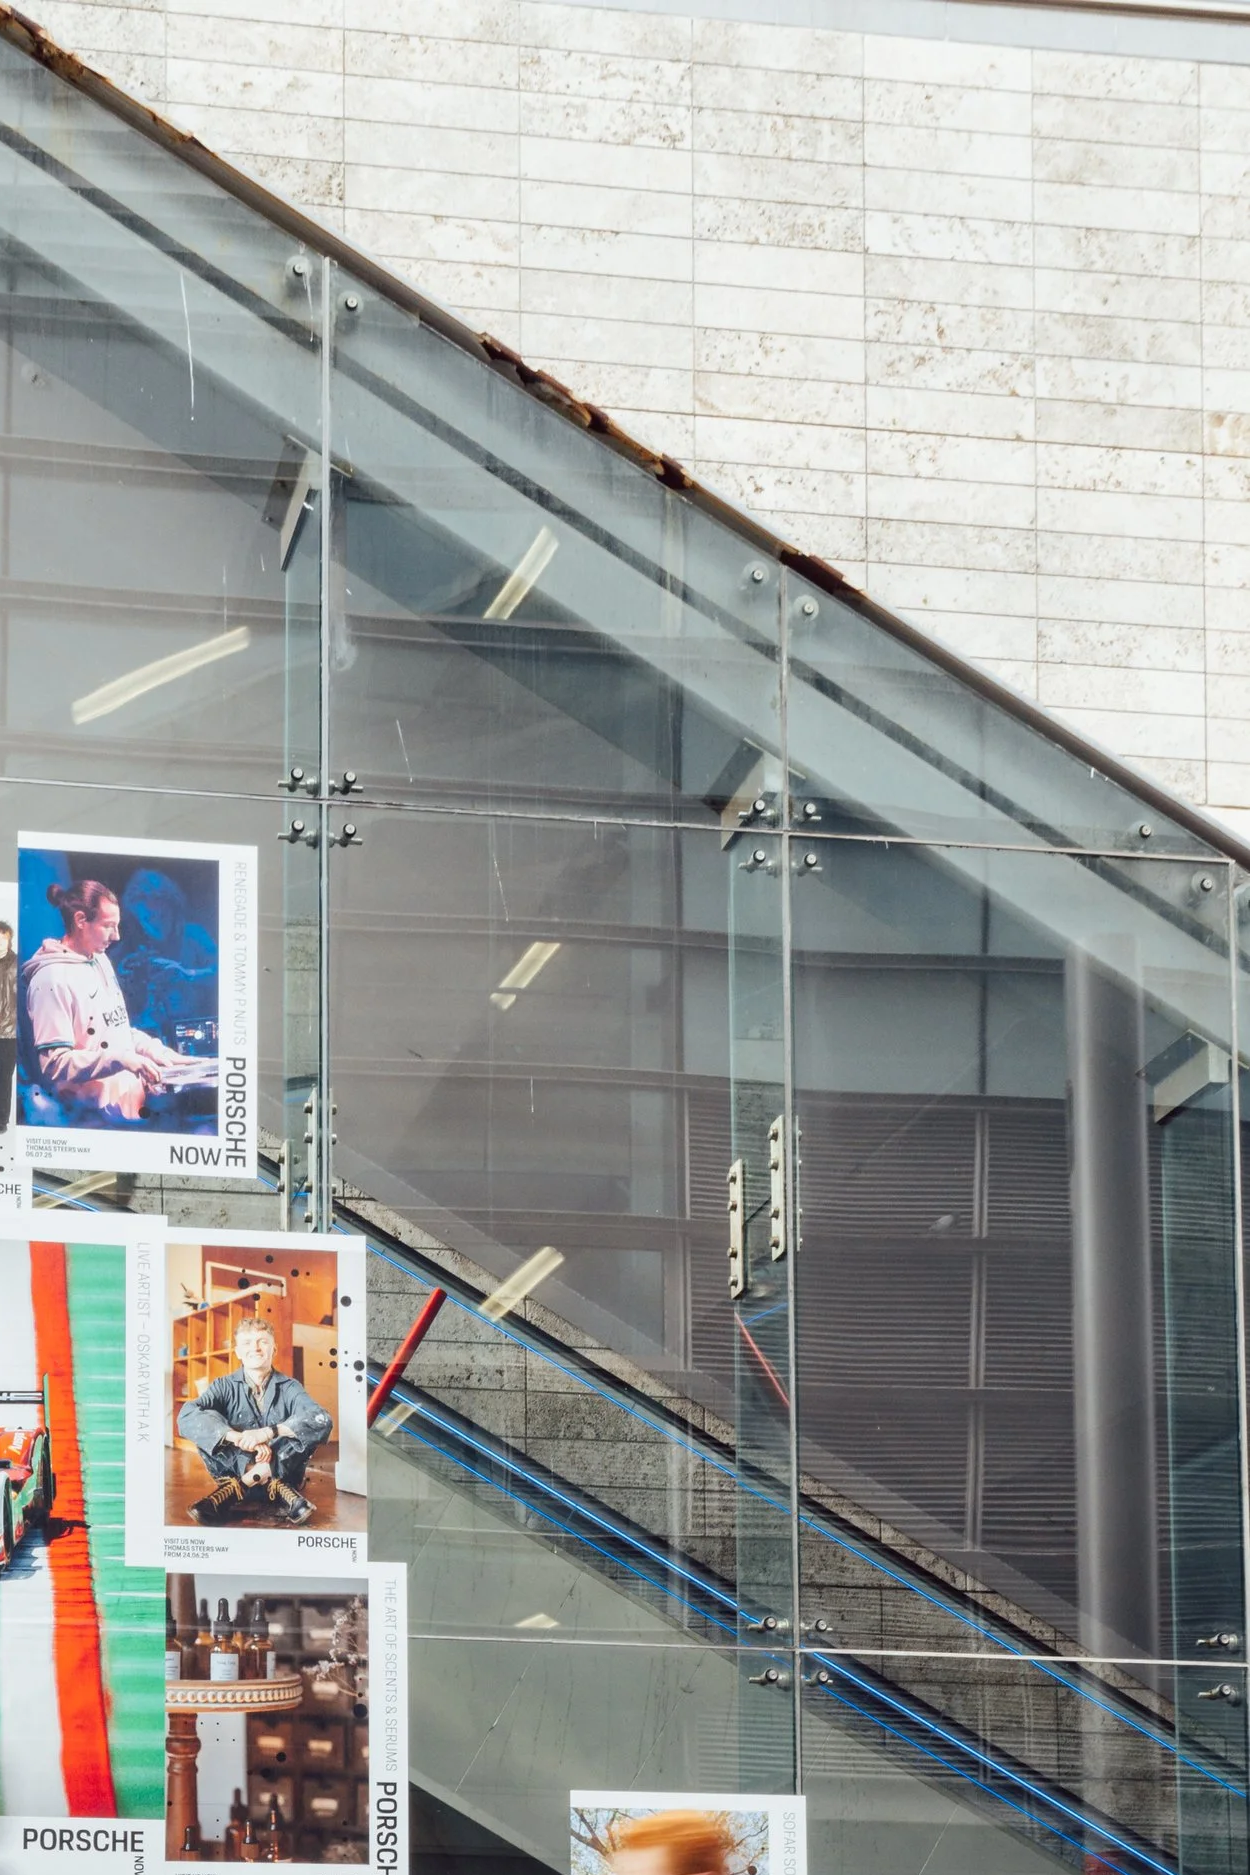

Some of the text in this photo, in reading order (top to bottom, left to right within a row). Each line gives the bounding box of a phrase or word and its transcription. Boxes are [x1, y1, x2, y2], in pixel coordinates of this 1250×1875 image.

[234, 862, 247, 929] RENEGADE
[234, 933, 247, 942] &
[234, 946, 247, 995] TOMMY
[226, 1057, 246, 1167] PORSCHE
[170, 1146, 221, 1166] NOW
[137, 1242, 151, 1271] LIVE
[137, 1273, 151, 1319] ARTIST
[137, 1334, 151, 1380] OSKAR
[137, 1382, 151, 1418] WITH
[298, 1536, 356, 1548] PORSCHE
[384, 1579, 398, 1771] THE ART OF SCENTS & SERUMS
[23, 1828, 143, 1852] PORSCHE
[783, 1812, 796, 1854] SOFAR
